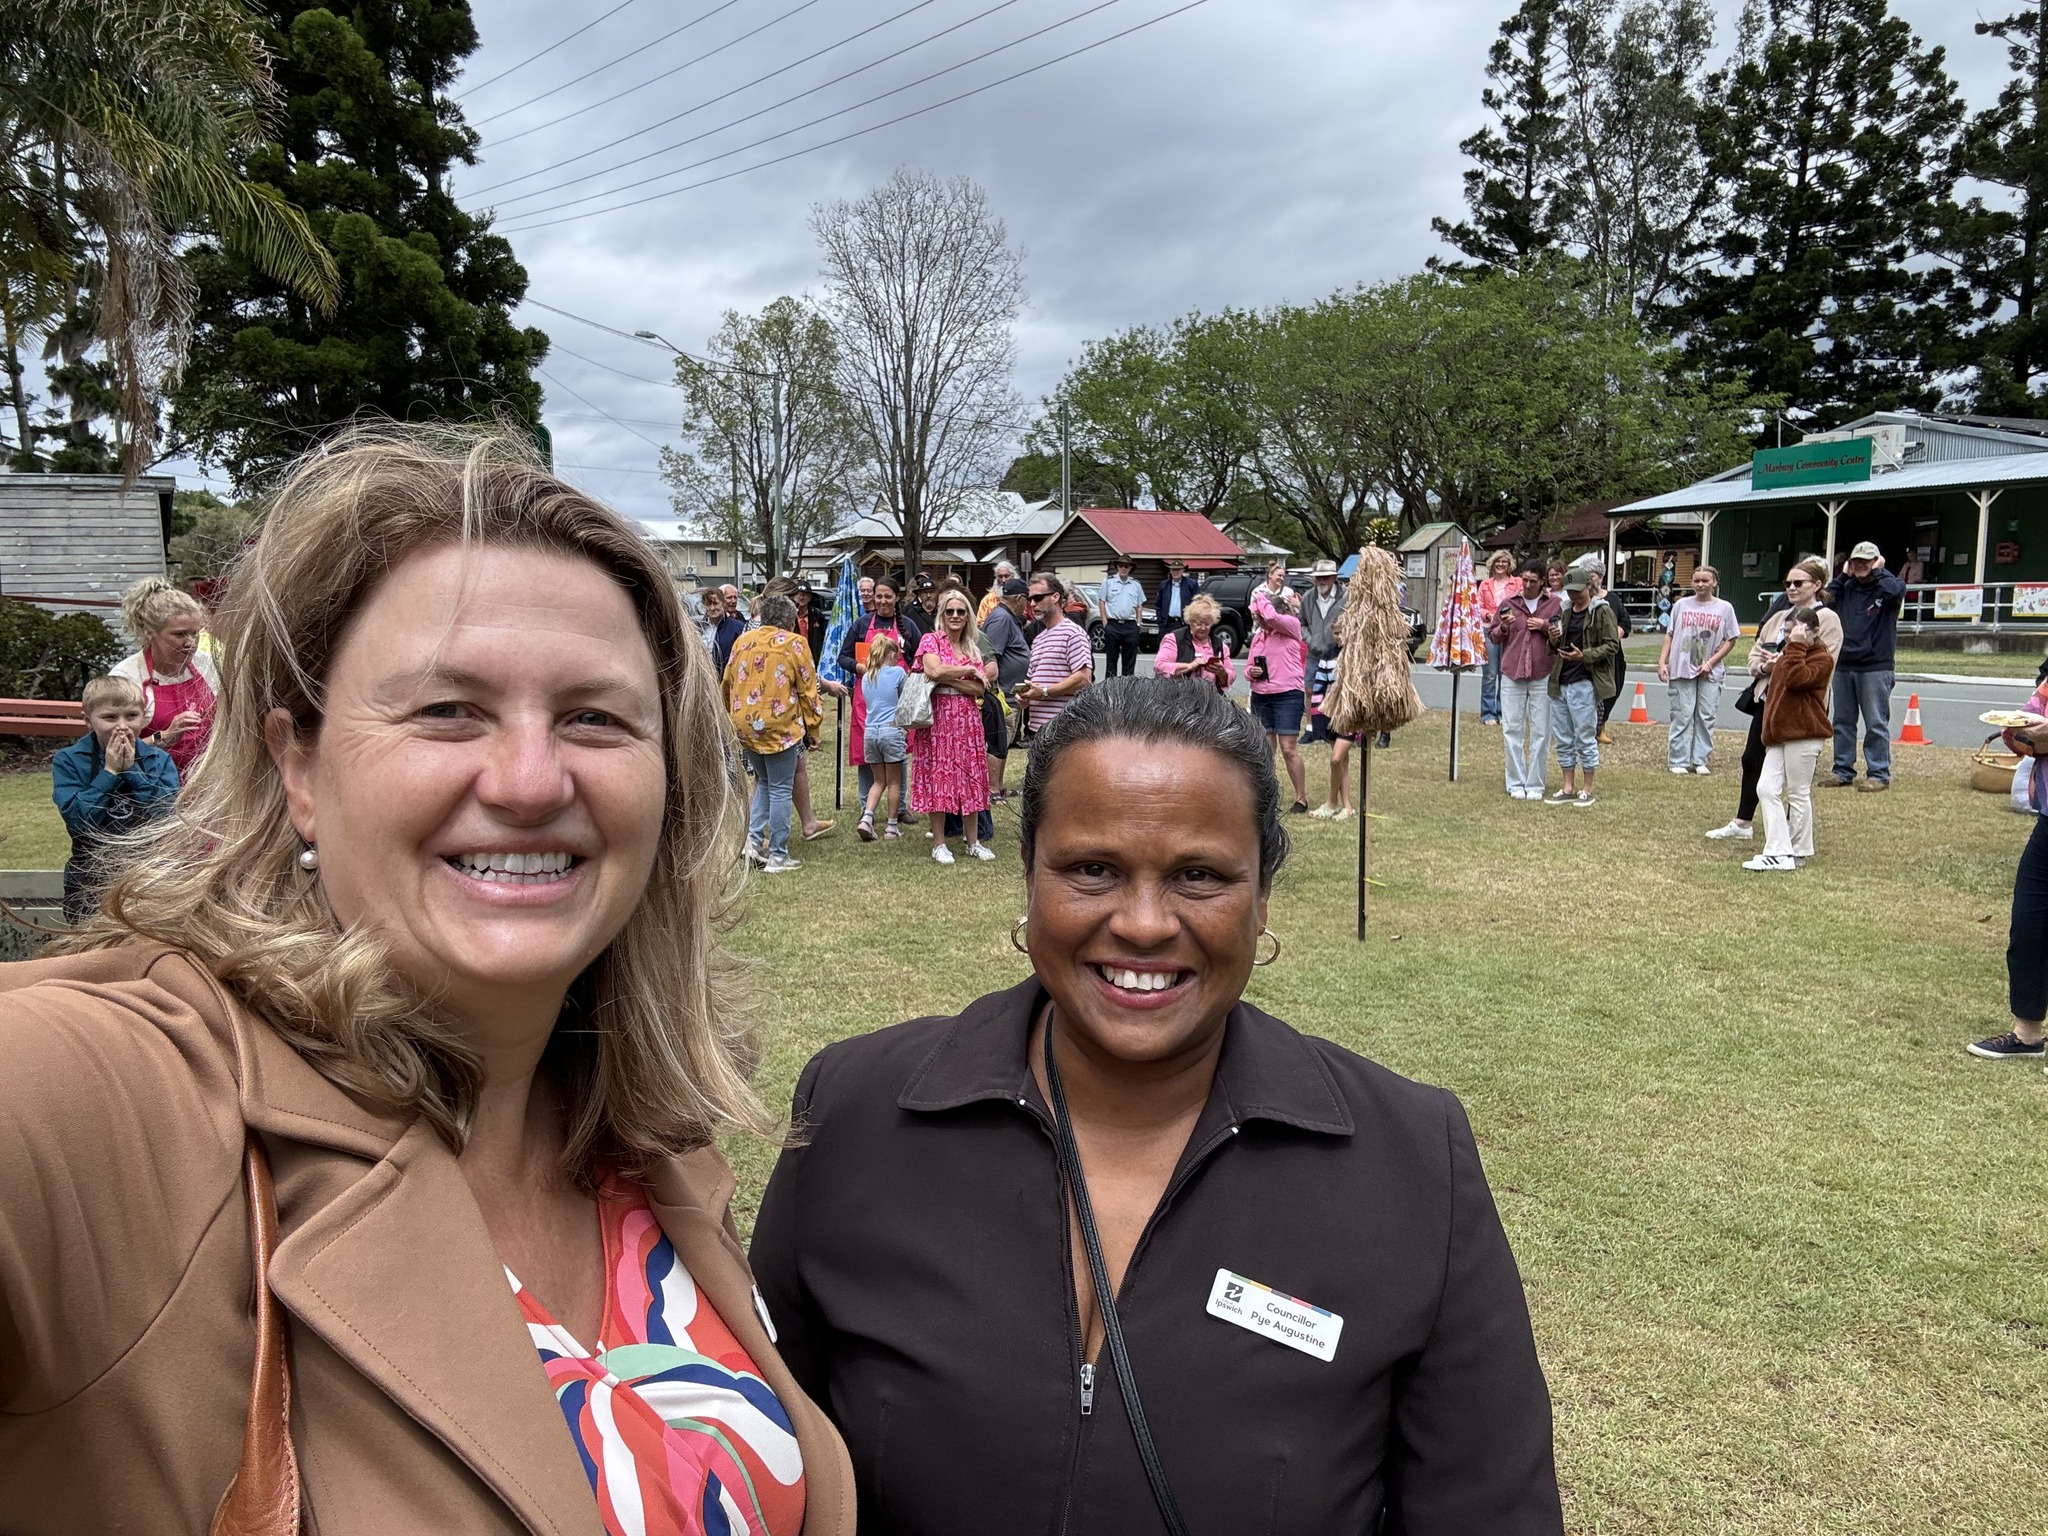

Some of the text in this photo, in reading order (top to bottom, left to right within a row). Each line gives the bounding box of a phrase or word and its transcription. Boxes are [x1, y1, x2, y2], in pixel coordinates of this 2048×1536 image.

[1758, 454, 1866, 475] Marbury Community Centre
[1215, 1298, 1243, 1315] Ipswich
[1266, 1302, 1317, 1329] Councillor
[1250, 1310, 1326, 1349] Pye Augustine
